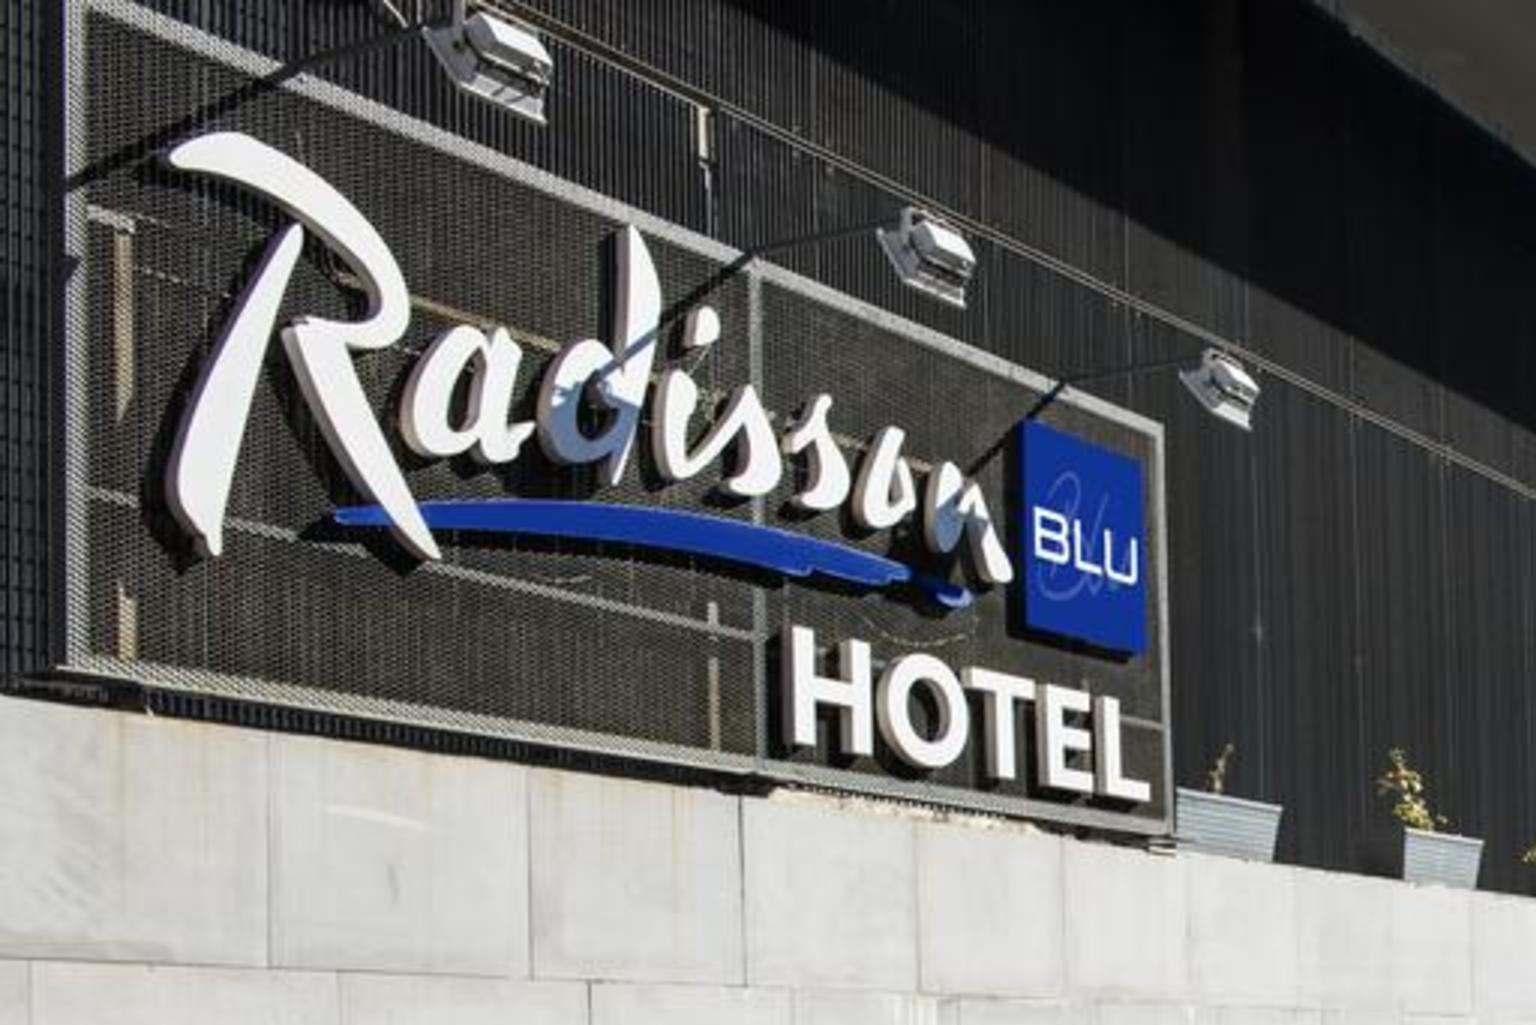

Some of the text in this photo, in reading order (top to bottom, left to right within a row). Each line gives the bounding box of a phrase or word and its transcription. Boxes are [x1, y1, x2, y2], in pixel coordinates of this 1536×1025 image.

[168, 130, 1014, 584] Radisson
[1033, 506, 1139, 586] BLU
[780, 624, 1152, 802] HOTEL
